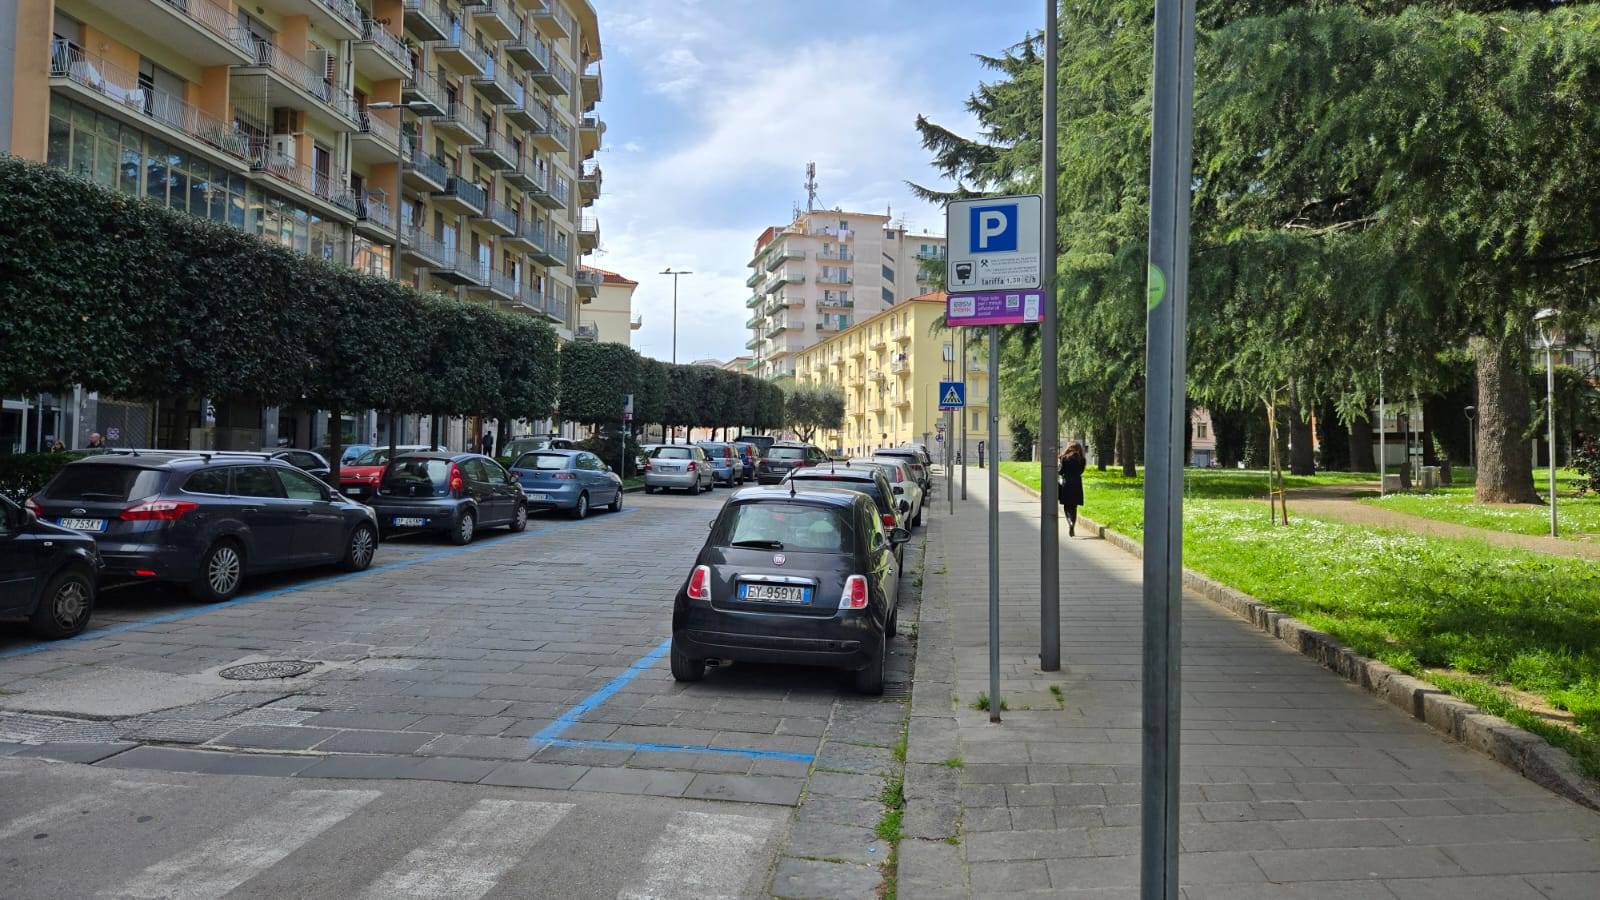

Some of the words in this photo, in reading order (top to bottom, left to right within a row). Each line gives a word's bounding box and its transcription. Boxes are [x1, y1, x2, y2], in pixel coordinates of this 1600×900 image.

[979, 210, 1008, 249] P
[982, 277, 1004, 285] tariffa
[748, 585, 761, 597] EY
[766, 586, 802, 599] 959YA
